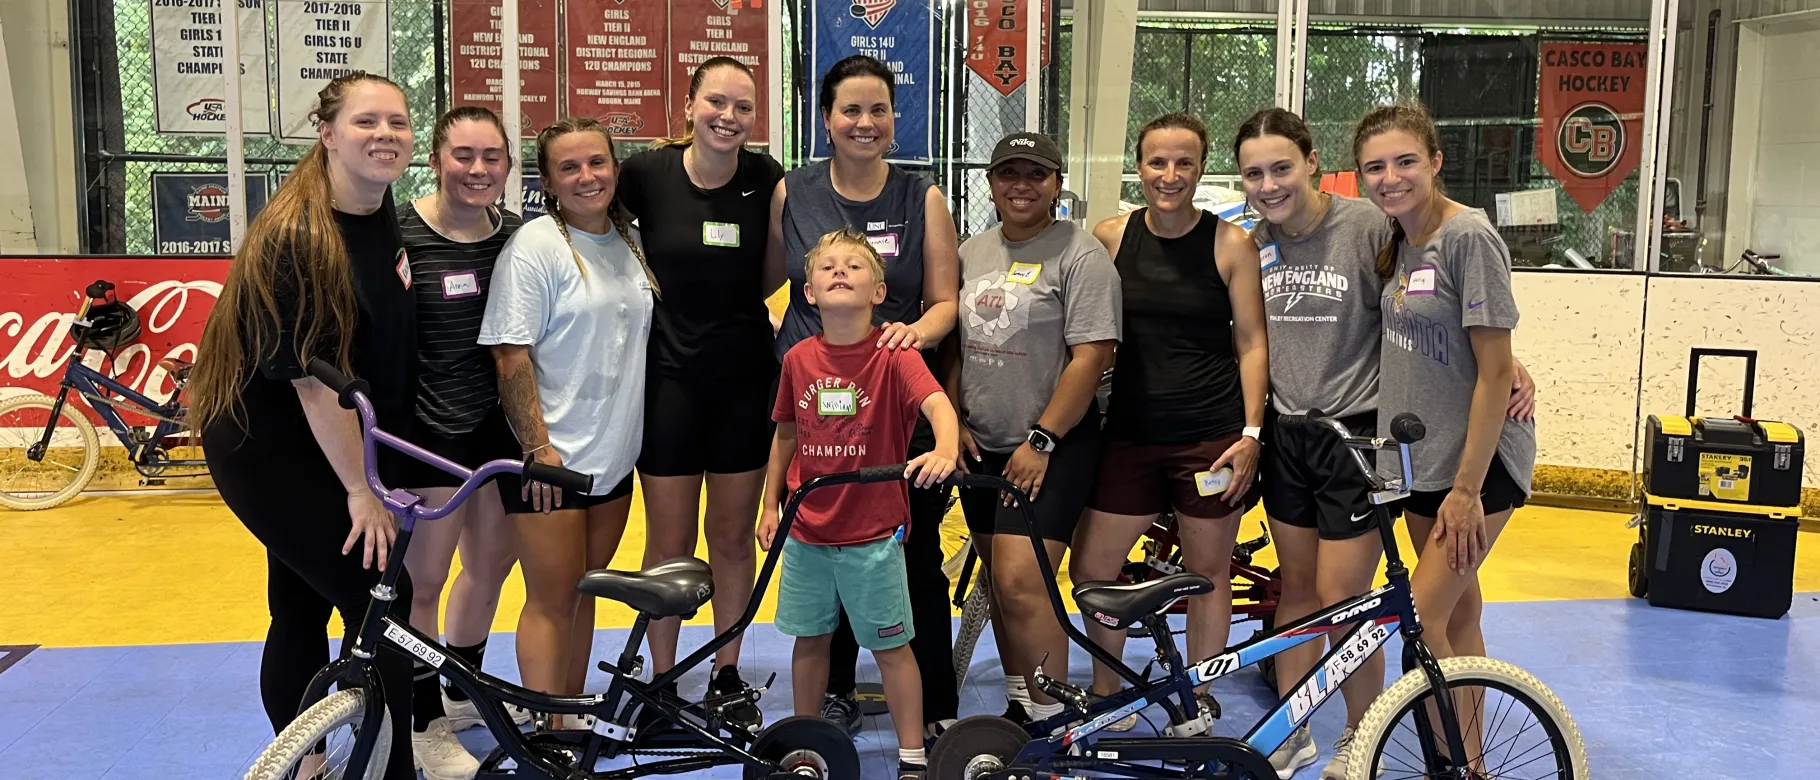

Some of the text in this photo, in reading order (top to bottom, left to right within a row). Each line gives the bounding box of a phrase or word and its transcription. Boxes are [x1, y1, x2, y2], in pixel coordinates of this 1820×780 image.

[303, 1, 361, 16] 2017-2018
[604, 9, 629, 20] GIRLS
[191, 12, 216, 24] TIER
[706, 15, 731, 27] GIRLS
[315, 19, 350, 31] TIER II
[603, 22, 630, 33] TIER II
[180, 29, 213, 41] GIRLS
[473, 32, 493, 43] NEW
[706, 28, 733, 39] TIER II
[304, 35, 362, 48] GIRLS 16 U
[587, 35, 647, 46] NEW ENGLAND
[690, 40, 749, 52] NEW ENGLAND
[850, 36, 895, 48] GIRLS 14U
[460, 45, 503, 56] DISTRICT
[576, 47, 657, 58] DISTRICT REGIONAL
[316, 52, 348, 64] STATE
[470, 59, 486, 69] 12U
[1544, 50, 1648, 69] CASCO BAY
[177, 62, 246, 75] CHAMPIS
[584, 61, 652, 72] 12U CHAMPIONS
[993, 45, 1019, 87] BAY
[595, 80, 617, 88] MARCH
[1559, 74, 1631, 93] HOCKEY
[576, 88, 601, 96] NORWAY
[602, 89, 627, 97] SAVINGS
[192, 113, 226, 121] HOCKE
[1564, 116, 1617, 162] CB
[161, 241, 221, 254] 2016-2017
[1269, 264, 1319, 273] UNIVERSITY
[1285, 270, 1348, 292] ENGLAND
[976, 294, 1002, 309] ATL
[1314, 315, 1338, 323] CENTER
[798, 376, 842, 410] BURGER
[802, 444, 866, 457] CHAMPION
[1694, 524, 1751, 539] STANLEY
[1331, 597, 1382, 625] DYNO
[388, 627, 442, 666] E 57 69 92
[1340, 650, 1355, 663] 58
[1356, 639, 1370, 653] 69
[1371, 628, 1387, 641] 92
[1203, 658, 1234, 678] 01
